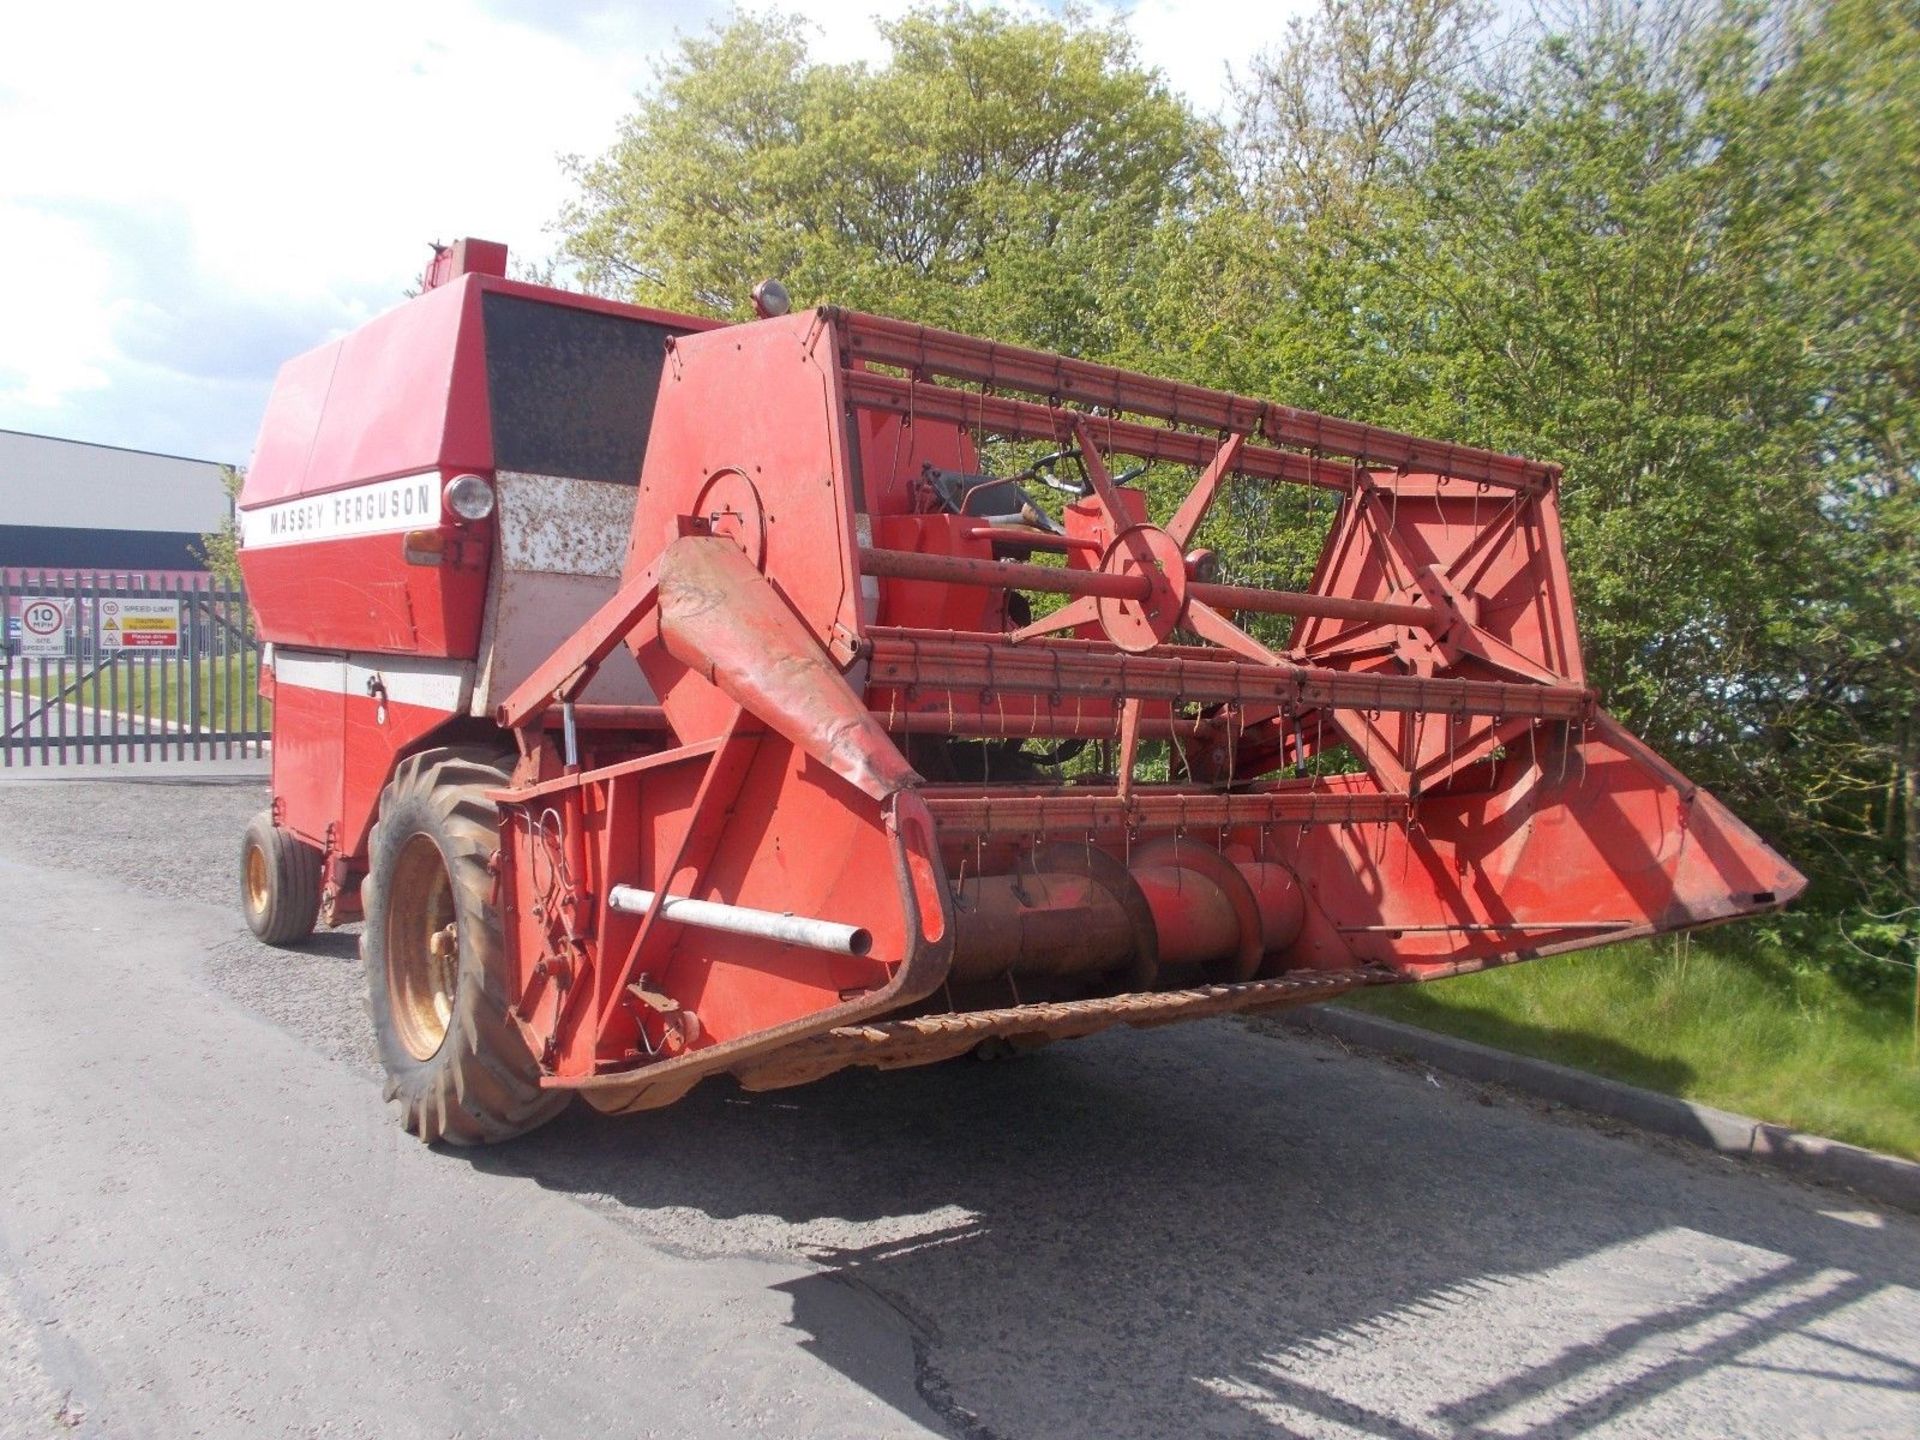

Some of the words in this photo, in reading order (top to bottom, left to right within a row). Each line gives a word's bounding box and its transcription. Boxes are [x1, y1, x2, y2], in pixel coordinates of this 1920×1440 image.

[271, 503, 324, 535] MASSEY
[334, 484, 430, 526] FERGUSON
[33, 608, 53, 621] 10
[124, 605, 152, 613] SPEED
